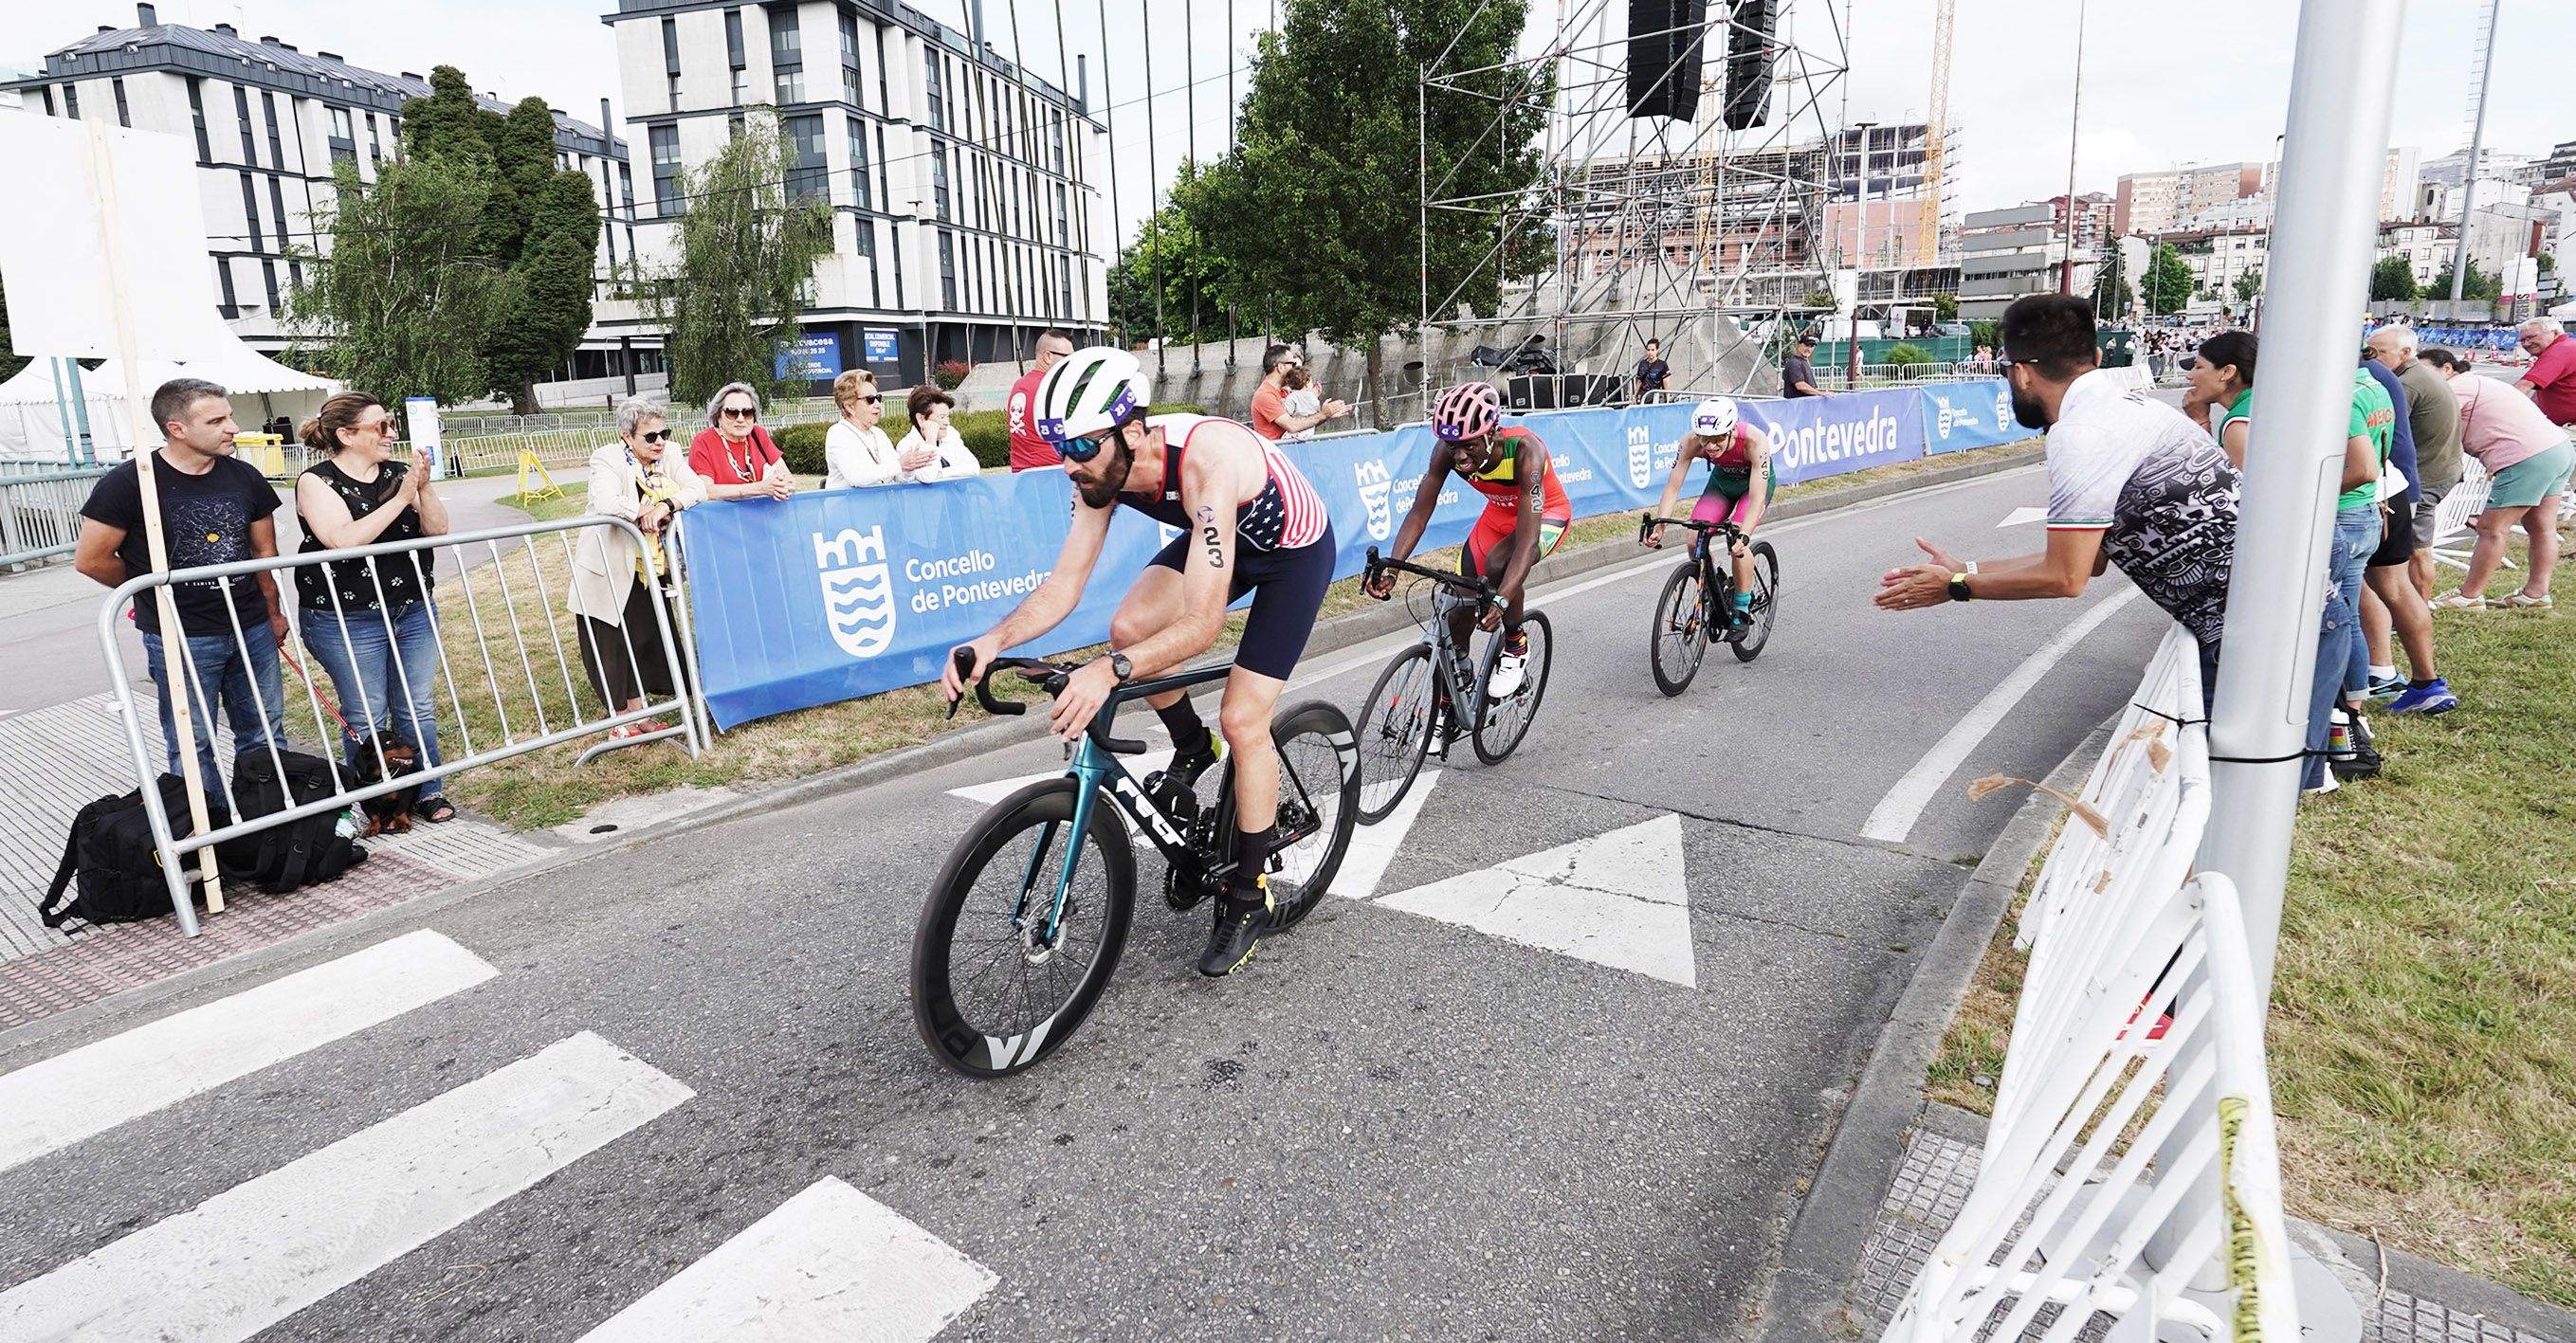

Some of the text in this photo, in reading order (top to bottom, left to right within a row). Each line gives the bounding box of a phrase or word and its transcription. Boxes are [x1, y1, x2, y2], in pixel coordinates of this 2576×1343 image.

[1768, 405, 1897, 468] Pontevedra
[1552, 454, 1570, 468] cello
[1396, 499, 1406, 513] de
[1530, 482, 1544, 513] 42
[1203, 526, 1224, 569] 23
[905, 550, 996, 583] Concello
[911, 589, 940, 614] de
